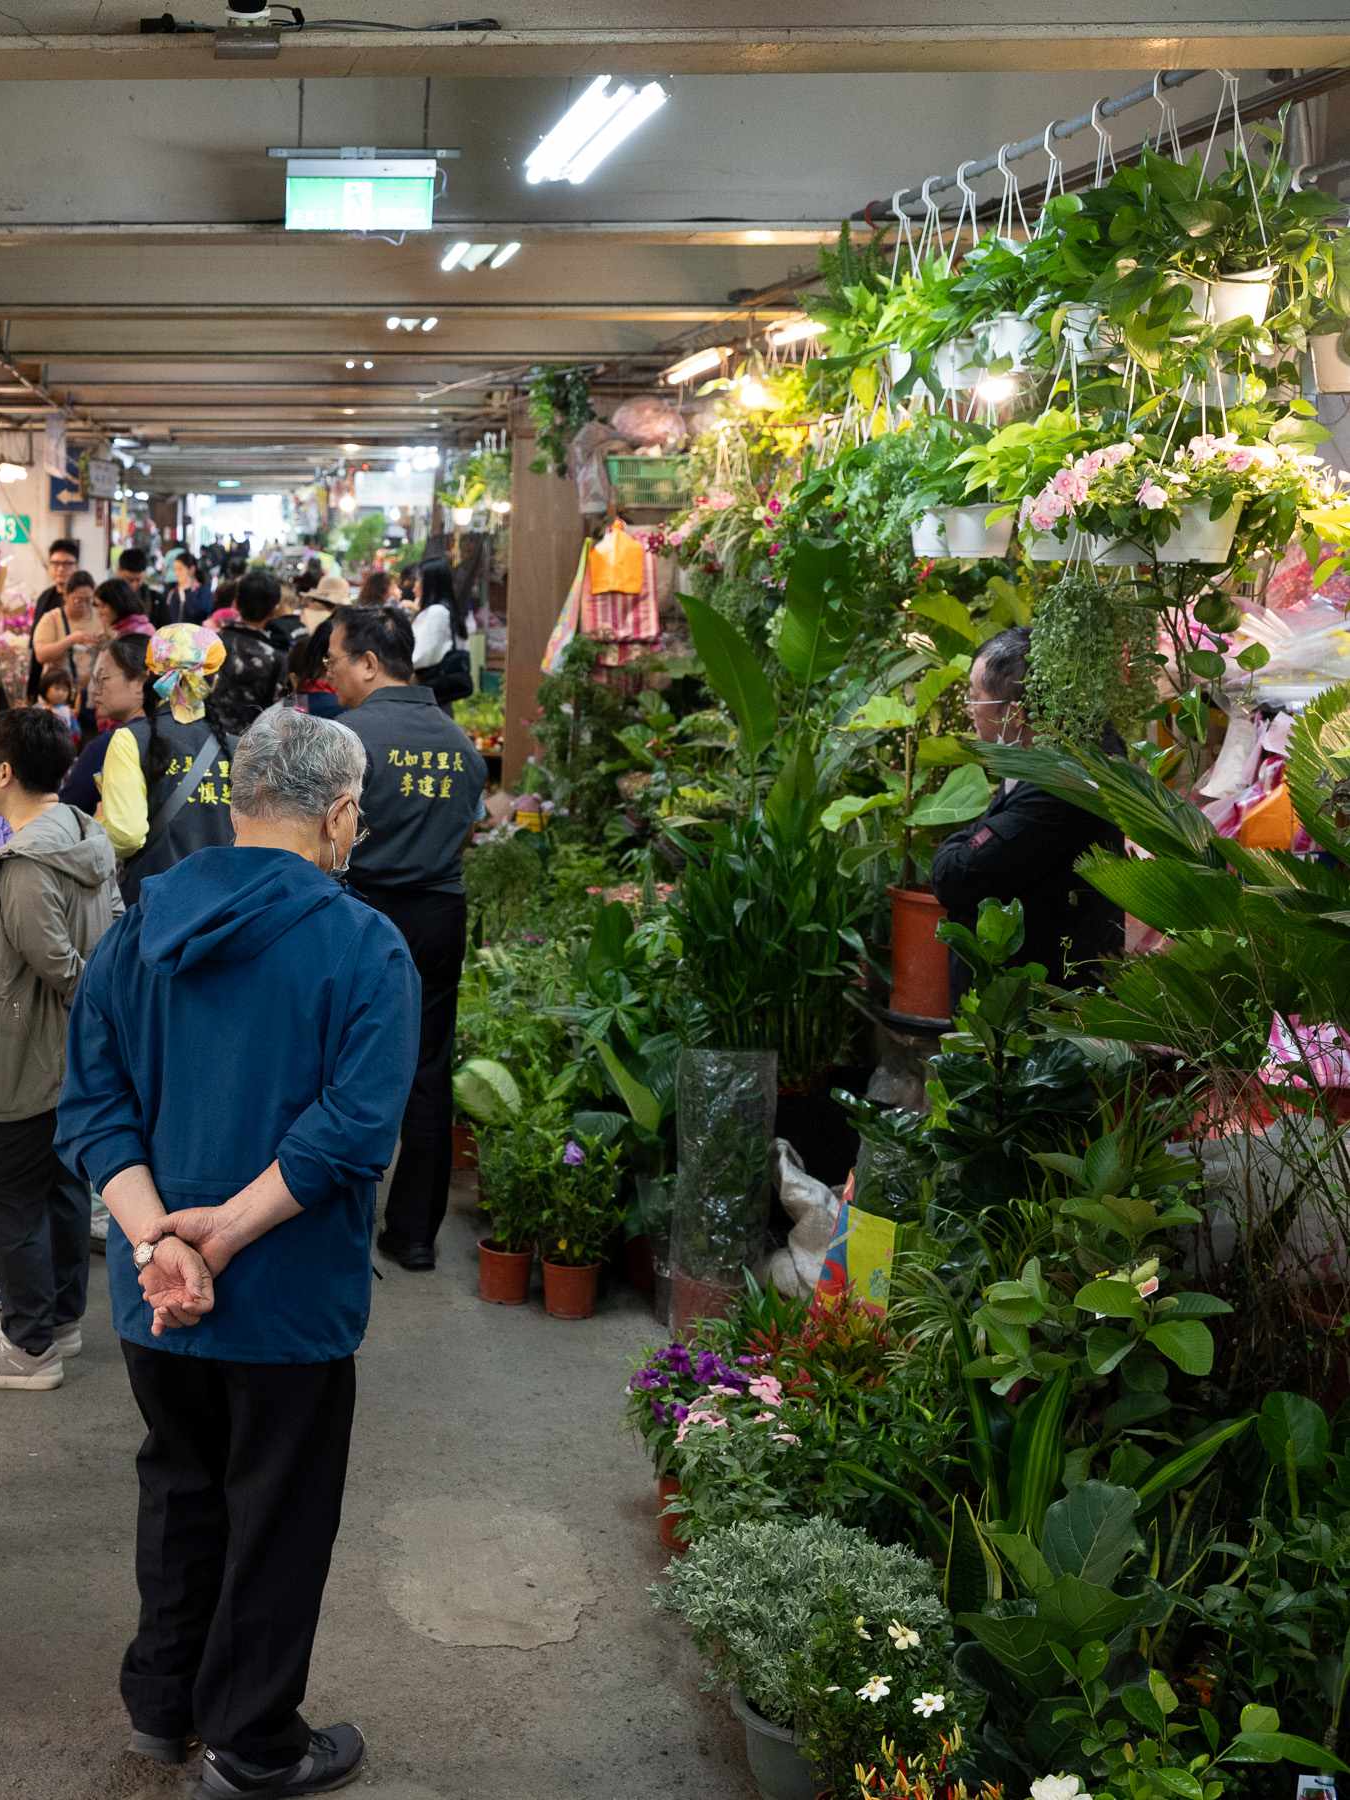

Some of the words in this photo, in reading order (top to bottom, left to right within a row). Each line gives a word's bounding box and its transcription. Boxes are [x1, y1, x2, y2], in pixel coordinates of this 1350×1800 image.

[388, 749, 464, 771] 九如里里長
